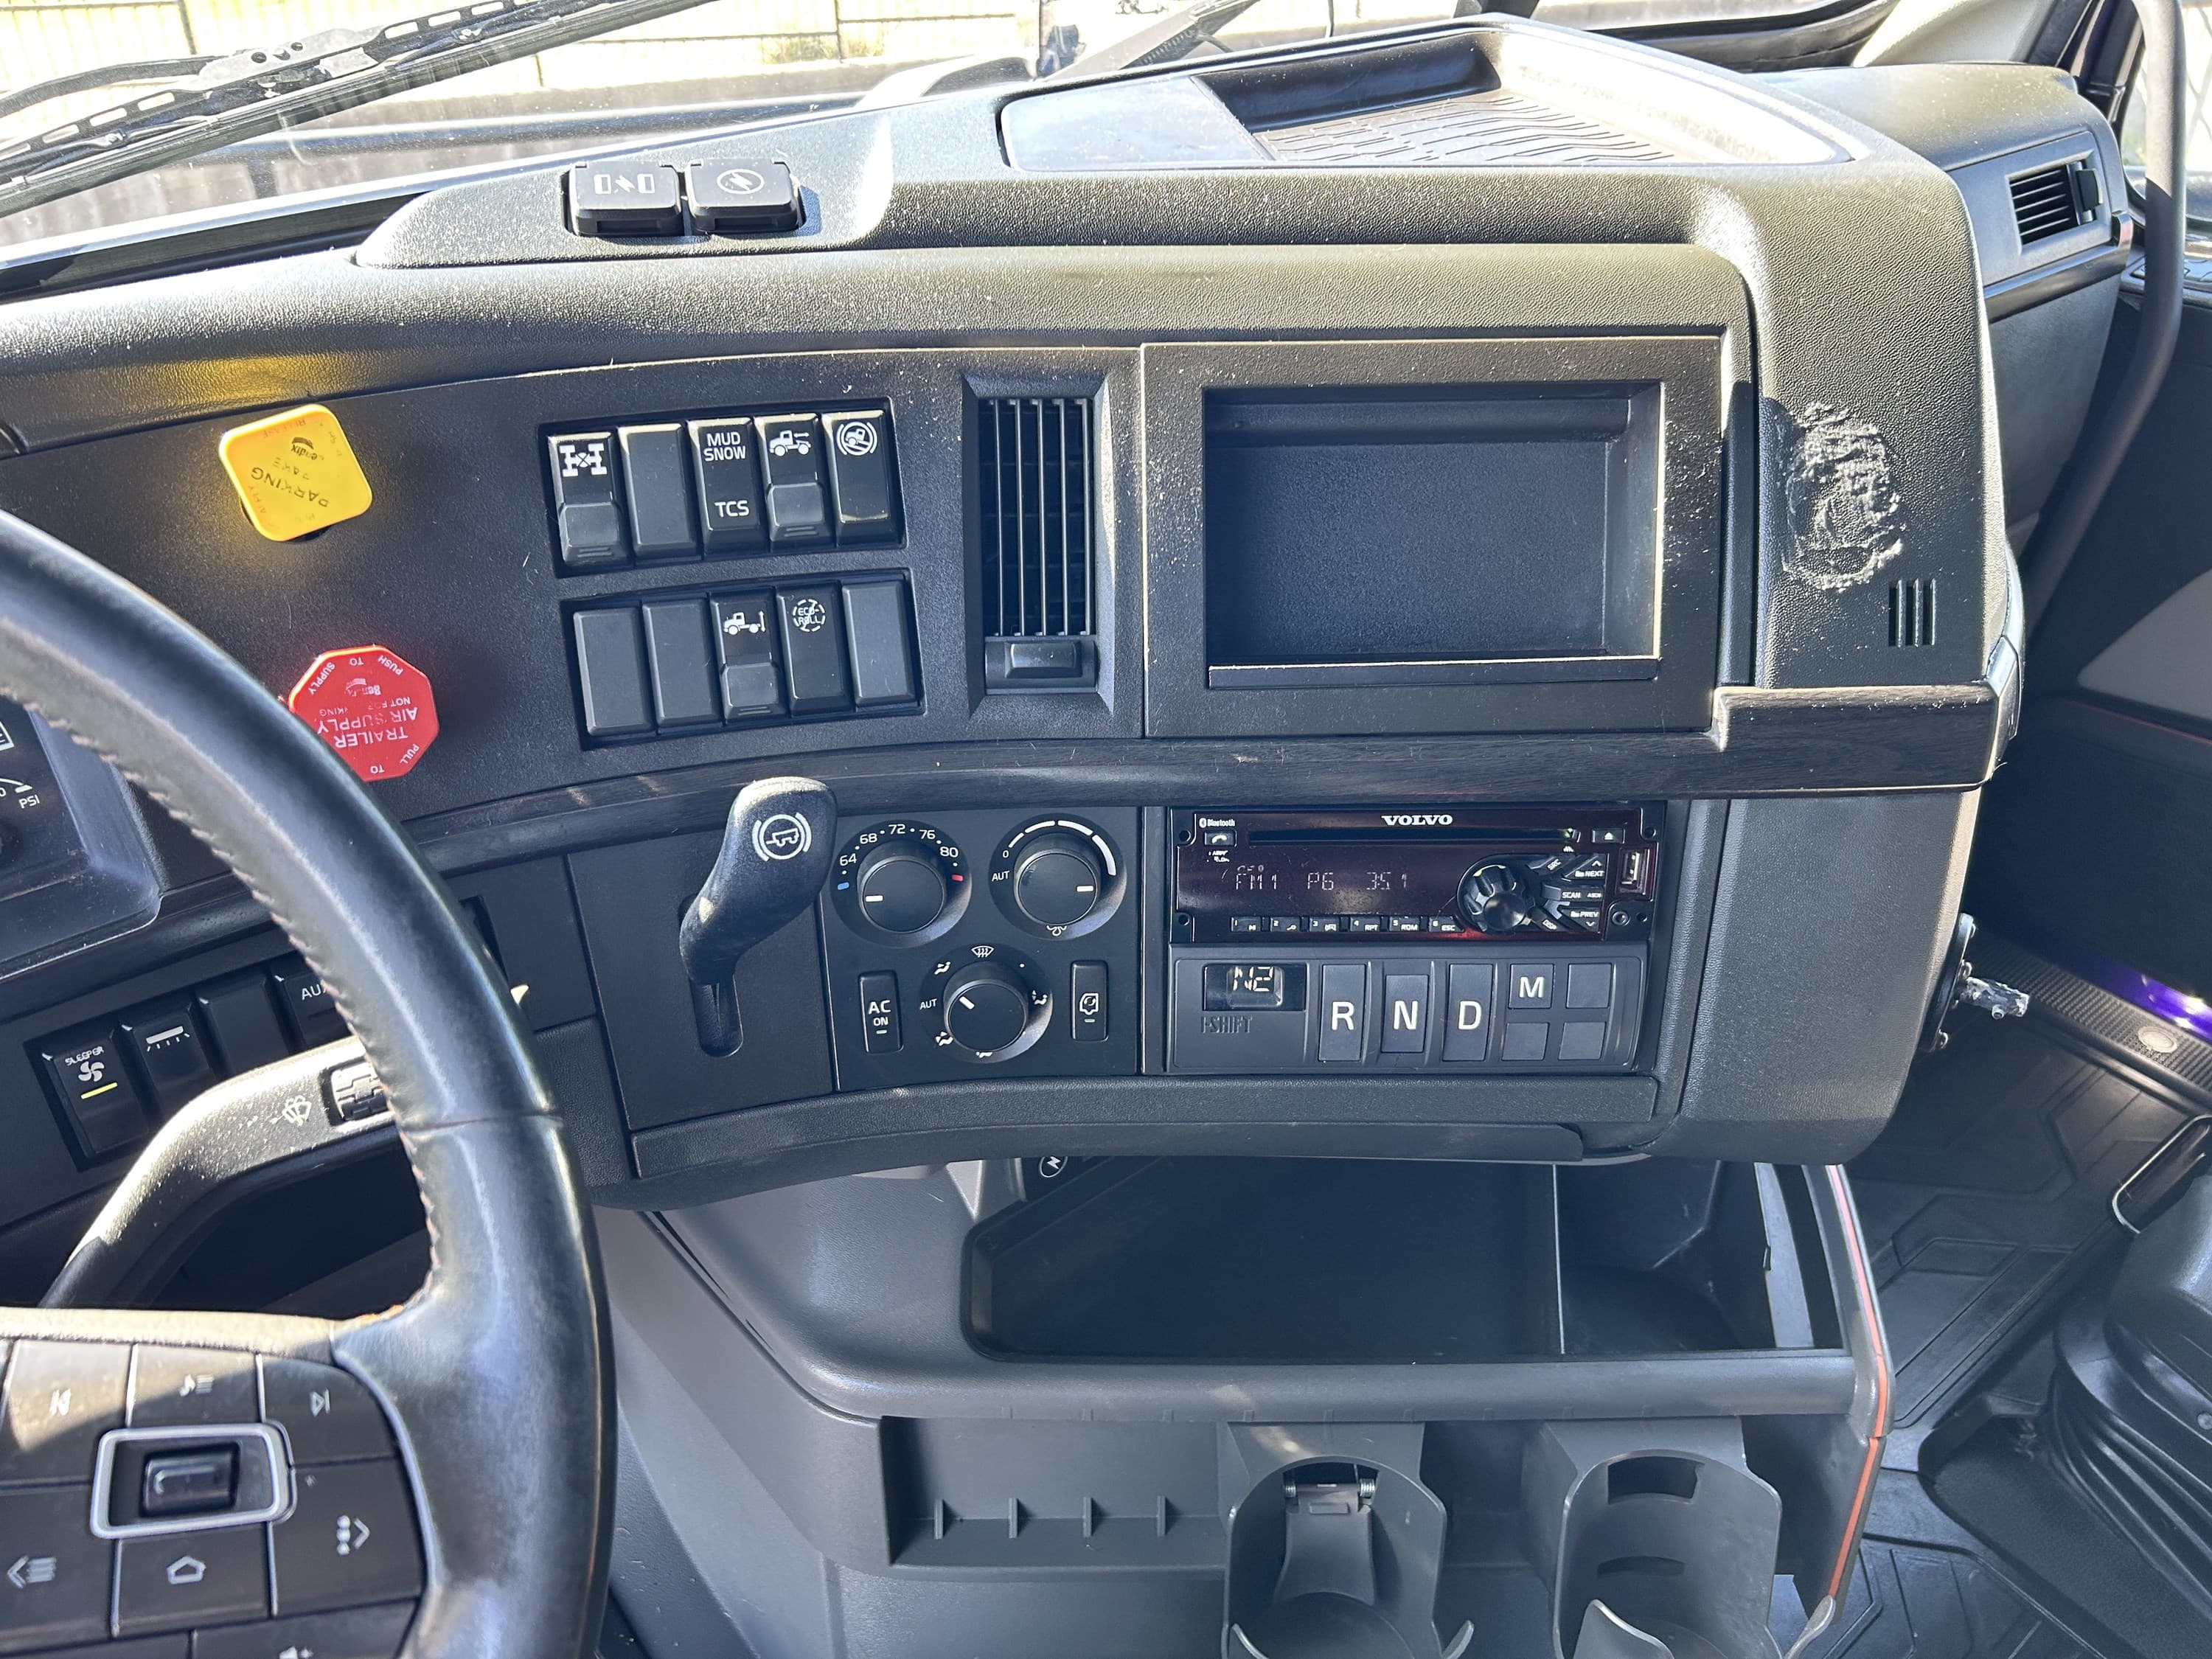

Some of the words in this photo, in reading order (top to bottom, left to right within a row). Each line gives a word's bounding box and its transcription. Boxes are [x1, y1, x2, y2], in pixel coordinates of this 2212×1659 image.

[706, 431, 740, 447] MUD
[703, 445, 746, 462] SNOW
[714, 500, 750, 517] TCS
[349, 656, 364, 667] TO
[378, 655, 404, 676] PUSH
[307, 661, 335, 695] SUPPLY
[390, 696, 411, 708] NOT
[317, 712, 385, 734] SUPPLY
[389, 706, 418, 723] AIR
[334, 726, 408, 748] TRAILER
[399, 743, 420, 765] PULL
[370, 765, 385, 774] TO
[18, 794, 40, 809] PSI
[1207, 818, 1235, 827] Bluetooth
[1381, 815, 1453, 826] VOLVO
[839, 853, 857, 866] 64
[860, 833, 877, 844] 68
[888, 824, 906, 835] 72
[919, 830, 936, 840] 76
[940, 846, 959, 858] 80
[1002, 850, 1009, 858] 0
[1547, 859, 1561, 871] SRC
[992, 871, 1009, 881] AUT
[1307, 872, 1334, 891] P6
[1232, 966, 1274, 992] N2
[1518, 976, 1545, 998] M
[302, 984, 326, 1001] AU
[868, 1000, 891, 1015] AC
[919, 998, 937, 1010] AUT
[873, 1017, 888, 1026] ON
[1331, 1001, 1354, 1031] R
[1393, 1001, 1418, 1030] N
[1458, 1001, 1482, 1030] D
[1201, 1016, 1253, 1033] I-SHIFT
[65, 1046, 104, 1066] SLEEPER
